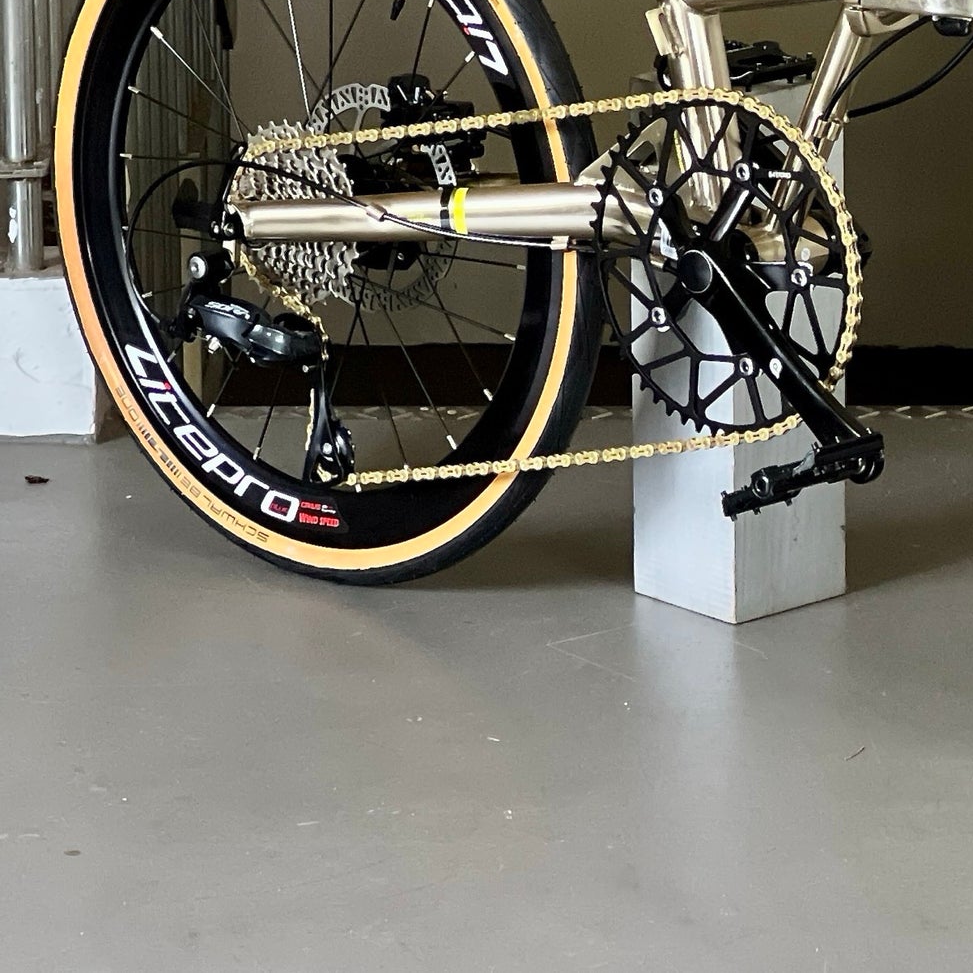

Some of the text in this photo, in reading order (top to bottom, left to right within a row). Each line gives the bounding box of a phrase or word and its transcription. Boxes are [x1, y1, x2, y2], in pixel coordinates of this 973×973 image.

[114, 386, 140, 424] ONE
[125, 343, 300, 523] Litepro
[181, 477, 270, 544] SCHWALBE
